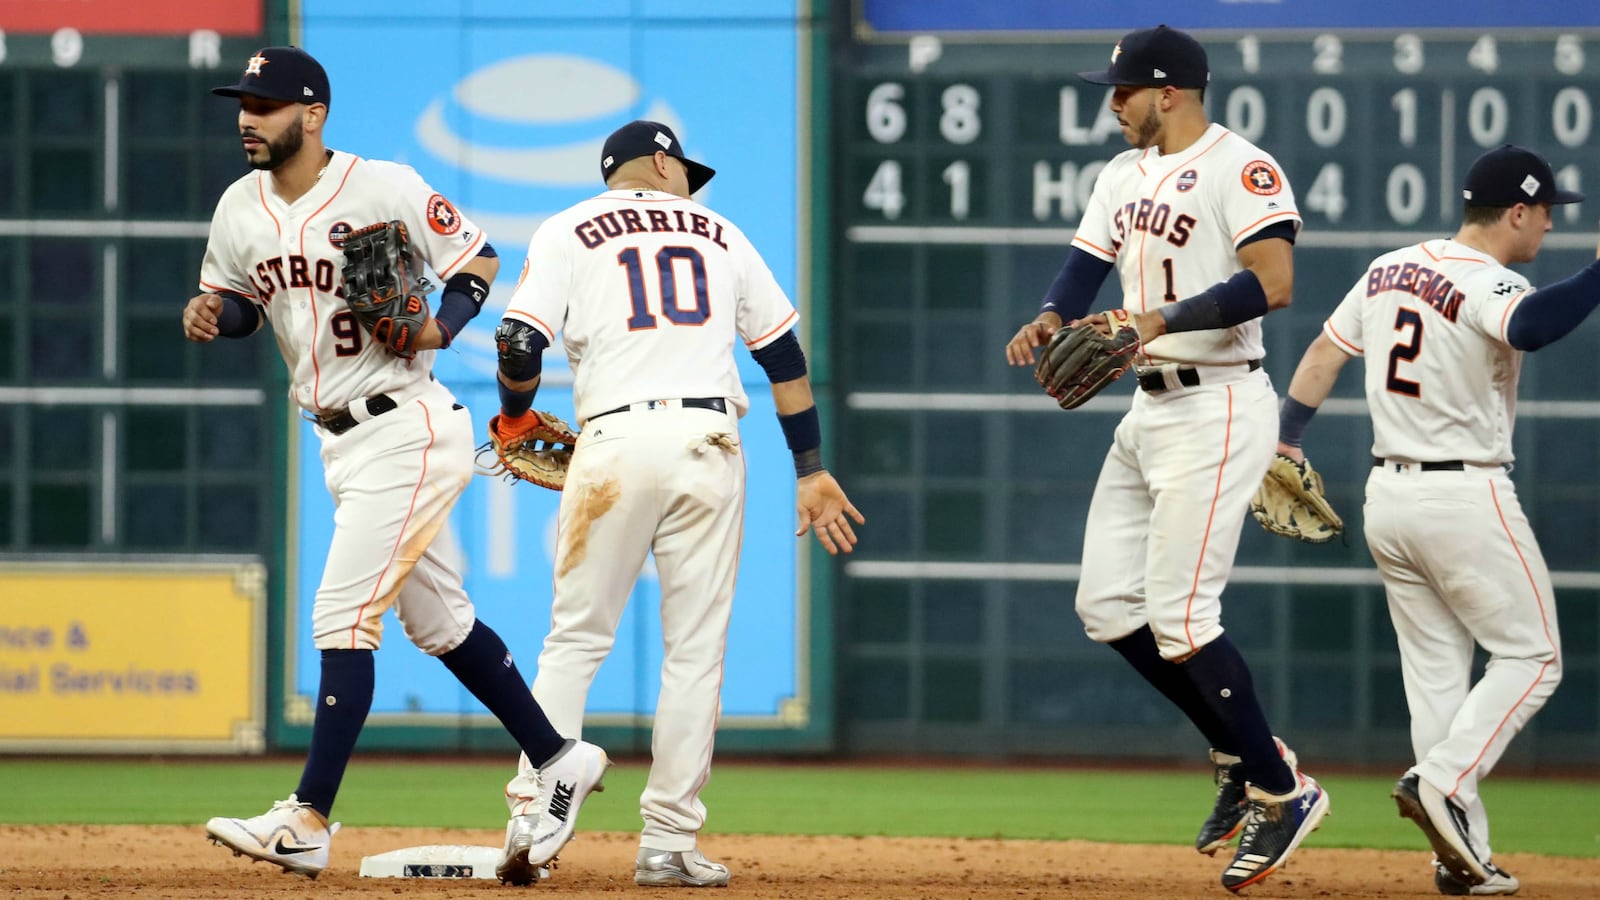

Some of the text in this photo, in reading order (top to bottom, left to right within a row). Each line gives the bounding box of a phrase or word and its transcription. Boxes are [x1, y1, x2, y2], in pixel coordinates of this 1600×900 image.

[908, 34, 1584, 74] P 1 2 3 4 5
[1306, 87, 1346, 147] 0
[1391, 88, 1417, 147] 1
[1468, 87, 1508, 147] 0
[1552, 87, 1592, 147] 0
[1304, 162, 1347, 223] 4
[1386, 163, 1426, 224] 0
[575, 208, 728, 251] GURRIEL
[1110, 197, 1198, 253] STROS
[248, 254, 346, 307] ASTRO
[618, 245, 711, 331] 10
[1162, 257, 1177, 302] 1
[1366, 262, 1466, 324] BREGMAN
[330, 311, 364, 358] 9
[1386, 306, 1424, 399] 2
[50, 662, 200, 693] Services
[548, 780, 577, 823] NIKE
